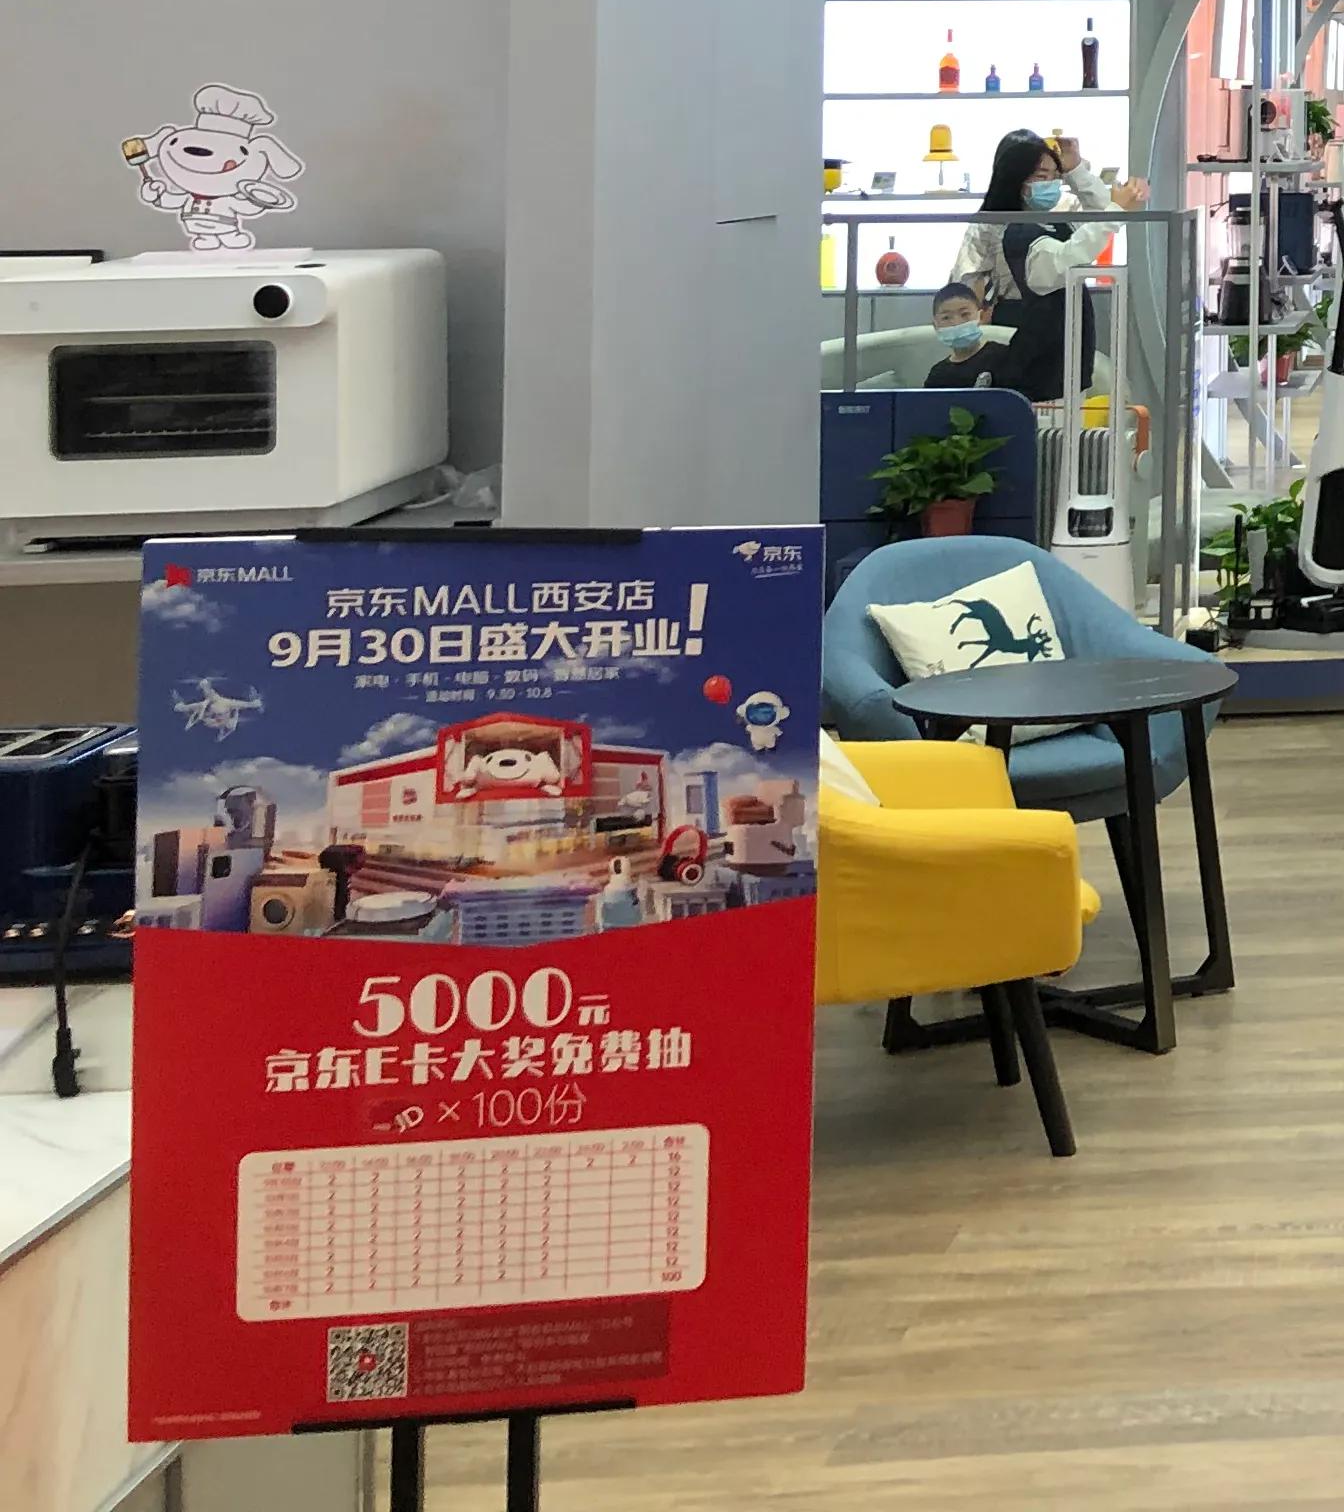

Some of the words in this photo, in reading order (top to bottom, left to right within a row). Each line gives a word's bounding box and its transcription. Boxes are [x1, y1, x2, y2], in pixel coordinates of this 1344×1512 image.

[762, 544, 804, 562] 京东
[196, 565, 295, 585] 京东MALL
[326, 580, 656, 619] 京东MALL西安店
[264, 1026, 693, 1093] 京东E卡大奖免费抽
